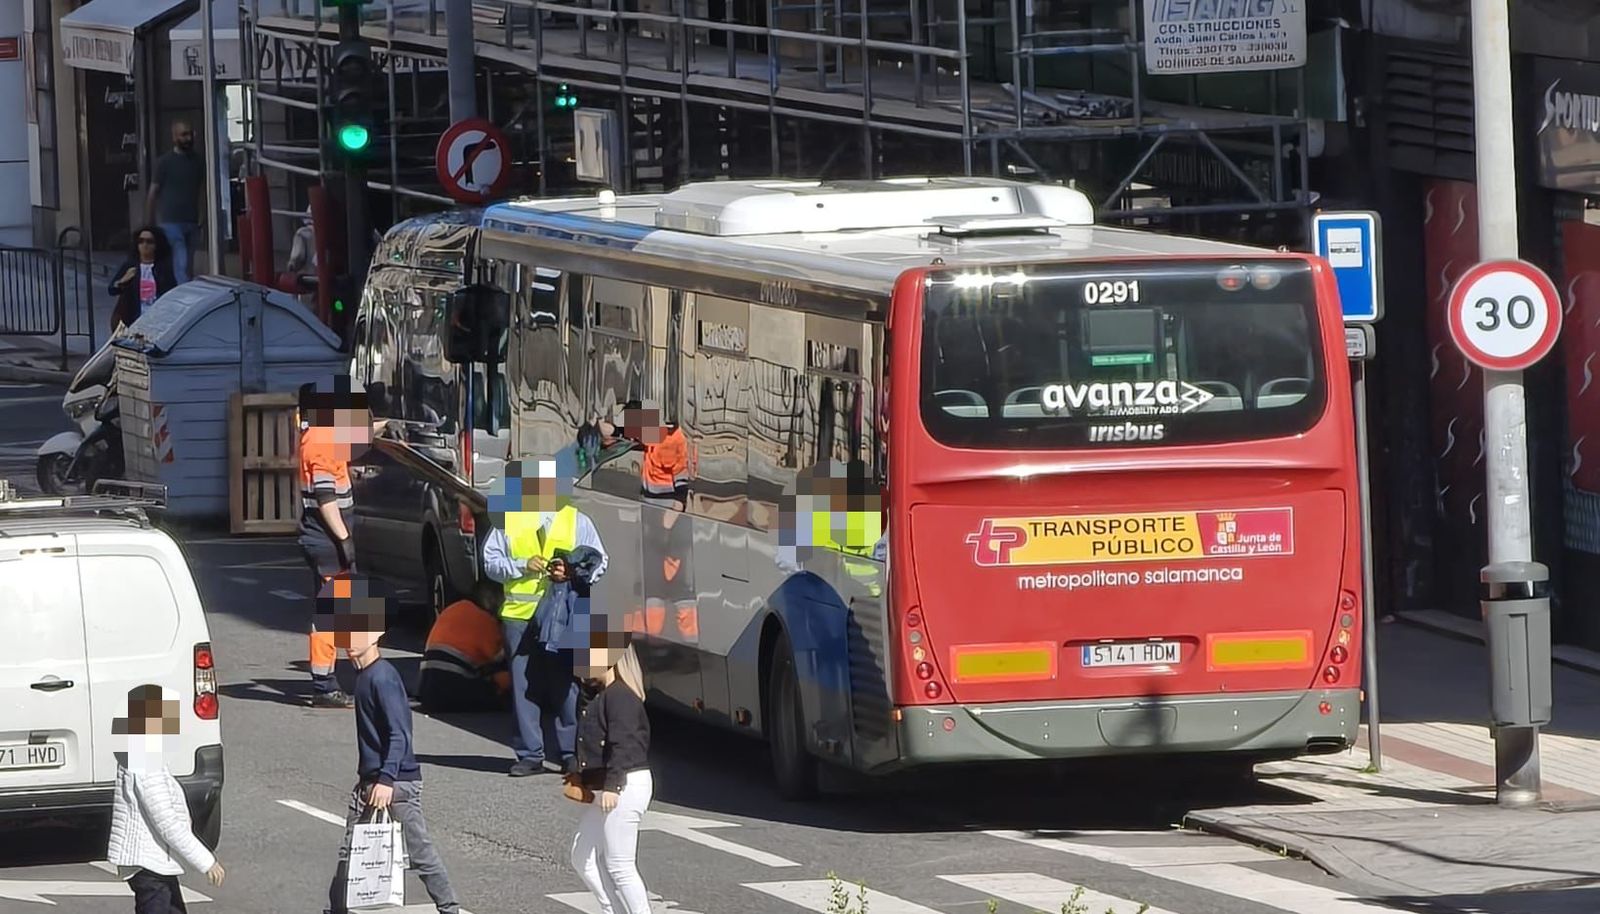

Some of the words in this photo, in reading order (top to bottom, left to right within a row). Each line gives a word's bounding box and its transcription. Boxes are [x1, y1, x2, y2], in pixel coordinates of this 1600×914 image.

[1159, 19, 1281, 35] CONSTRUCCIONES
[1227, 53, 1296, 66] SALAMANCA
[1085, 280, 1140, 304] 0291
[1474, 295, 1535, 331] 30
[1042, 380, 1179, 409] avanza
[1118, 406, 1159, 416] MOBILITY
[1159, 405, 1179, 414] ADO
[1029, 517, 1186, 537] TRANSPORTE
[1092, 536, 1194, 556] PÚBLICO
[1237, 533, 1266, 544] Junta
[1269, 532, 1282, 542] de
[1210, 544, 1246, 554] Castilla
[1248, 545, 1257, 555] y
[1258, 542, 1282, 553] León
[1018, 570, 1140, 590] metropolitano
[1144, 567, 1243, 585] salamanca
[1094, 645, 1135, 662] 5141
[1143, 643, 1176, 662] HDM
[28, 747, 57, 764] HVD
